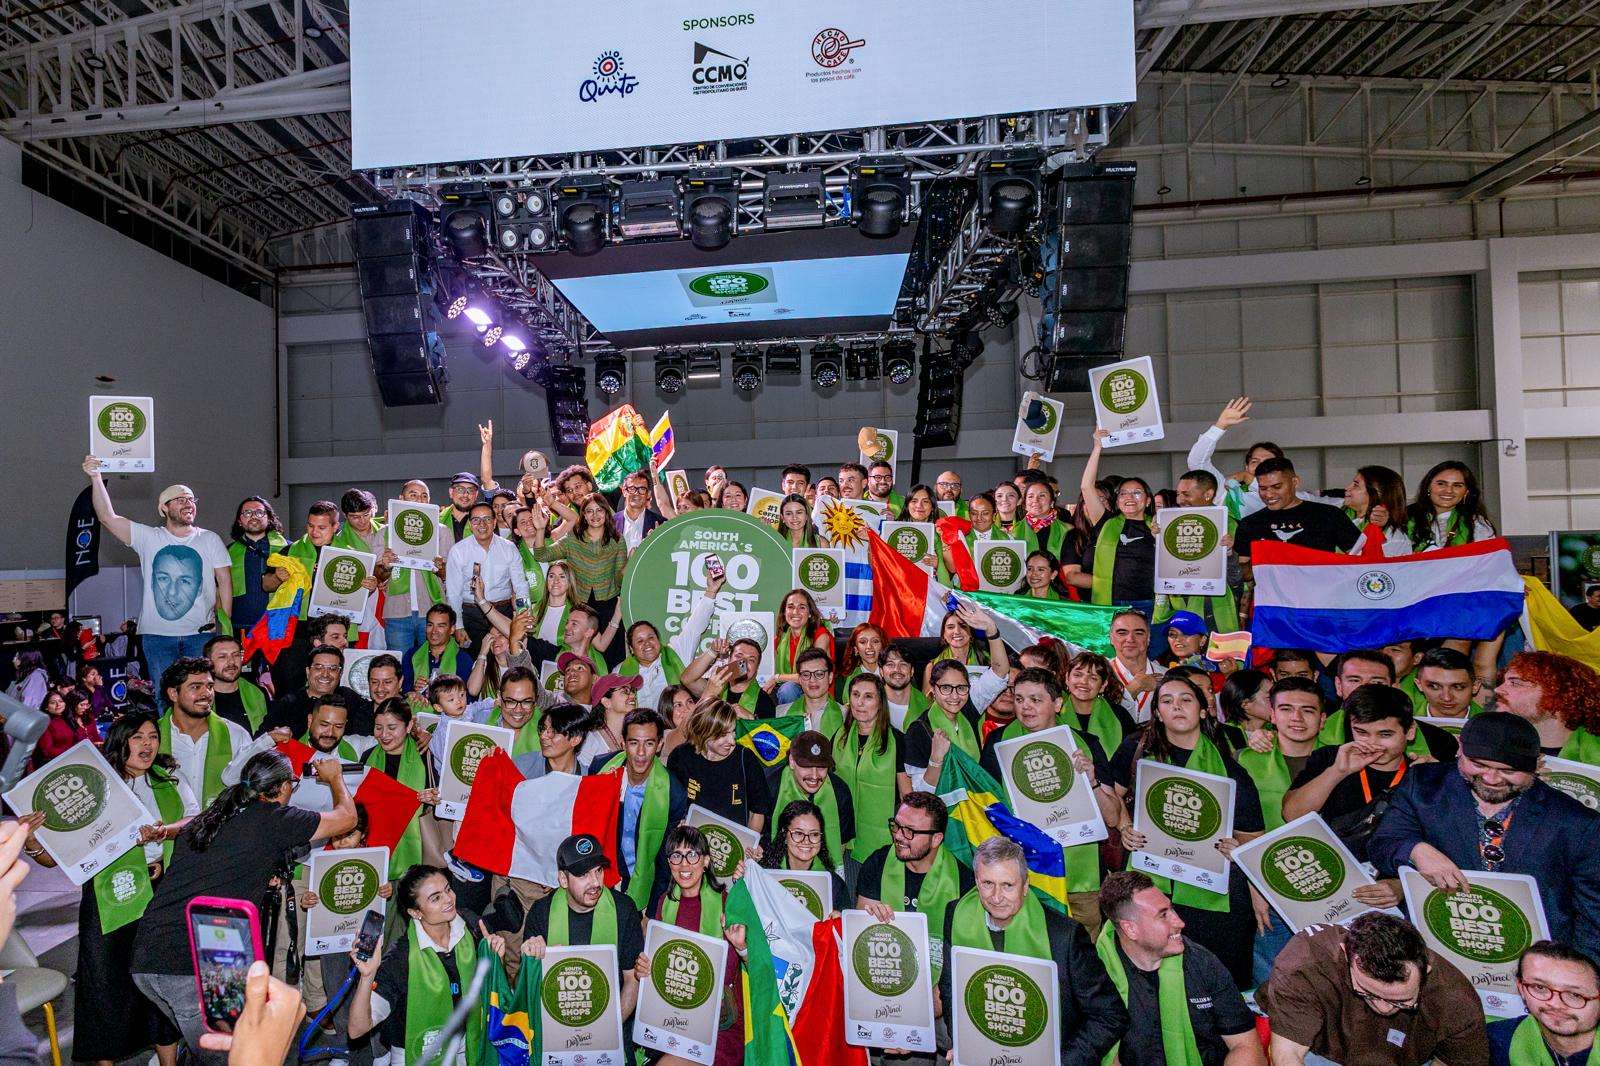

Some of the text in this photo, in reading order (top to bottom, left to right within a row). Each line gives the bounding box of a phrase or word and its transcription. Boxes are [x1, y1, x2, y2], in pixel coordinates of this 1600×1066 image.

[683, 13, 755, 31] SPONSORS
[816, 30, 845, 45] HECHO
[692, 64, 747, 84] CCMQ
[579, 73, 639, 102] Quito
[707, 277, 747, 286] 100
[1110, 378, 1135, 392] 100
[1111, 388, 1135, 399] BEST
[109, 412, 135, 422] 100
[404, 517, 424, 527] 100
[694, 530, 739, 542] SOUTH
[1176, 525, 1205, 536] 100
[897, 535, 918, 544] 100
[1176, 535, 1204, 543] BEST
[808, 562, 830, 571] 100
[991, 556, 1012, 565] 100
[333, 572, 355, 581] BEST
[336, 564, 357, 575] 100
[1023, 754, 1055, 771] 100
[1027, 767, 1058, 782] BEST
[1030, 776, 1061, 788] COFFEE
[1034, 783, 1061, 795] SHOPS
[45, 776, 83, 805] 100
[55, 785, 90, 815] BEST
[61, 793, 96, 820] COFFEE
[1164, 790, 1203, 811] 100
[67, 800, 97, 824] SHOPS
[1163, 802, 1201, 821] BEST
[1163, 813, 1200, 829] COFFEE
[1164, 820, 1197, 834] SHOPS
[1164, 847, 1195, 858] DaVinci
[1274, 849, 1315, 873] 100
[335, 872, 366, 886] 100
[1285, 860, 1323, 884] BEST
[1293, 869, 1330, 890] COFFEE
[1301, 877, 1333, 895] SHOPS
[334, 884, 364, 895] BEST
[1455, 891, 1483, 900] SOUTH
[335, 899, 361, 907] SHOPS
[1324, 898, 1350, 922] DaVinci
[1445, 901, 1501, 922] 100
[1450, 917, 1502, 936] BEST
[1452, 931, 1505, 945] COFFEE
[1457, 938, 1503, 952] SHOPS
[867, 942, 901, 958] 100
[668, 953, 700, 975] 100
[868, 957, 901, 969] BEST
[665, 967, 698, 986] BEST
[869, 969, 902, 977] COFFEE
[994, 974, 1015, 982] SOUTH
[1471, 973, 1510, 986] DaVinci
[557, 975, 593, 991] 100
[665, 978, 696, 994] COFFEE
[872, 976, 900, 985] SHOPS
[558, 990, 592, 1002] BEST
[665, 986, 693, 1000] SHOPS
[984, 982, 1026, 1005] 100
[559, 1001, 593, 1009] COFFEE
[561, 1008, 591, 1016] SHOPS
[874, 1005, 902, 1019] DaVinci
[984, 1000, 1026, 1019] BEST
[663, 1017, 689, 1028] DaVinci
[985, 1012, 1026, 1027] COFFEE
[987, 1021, 1024, 1035] SHOPS
[565, 1032, 592, 1049] DaVinci
[989, 1055, 1023, 1066] DaVinci
